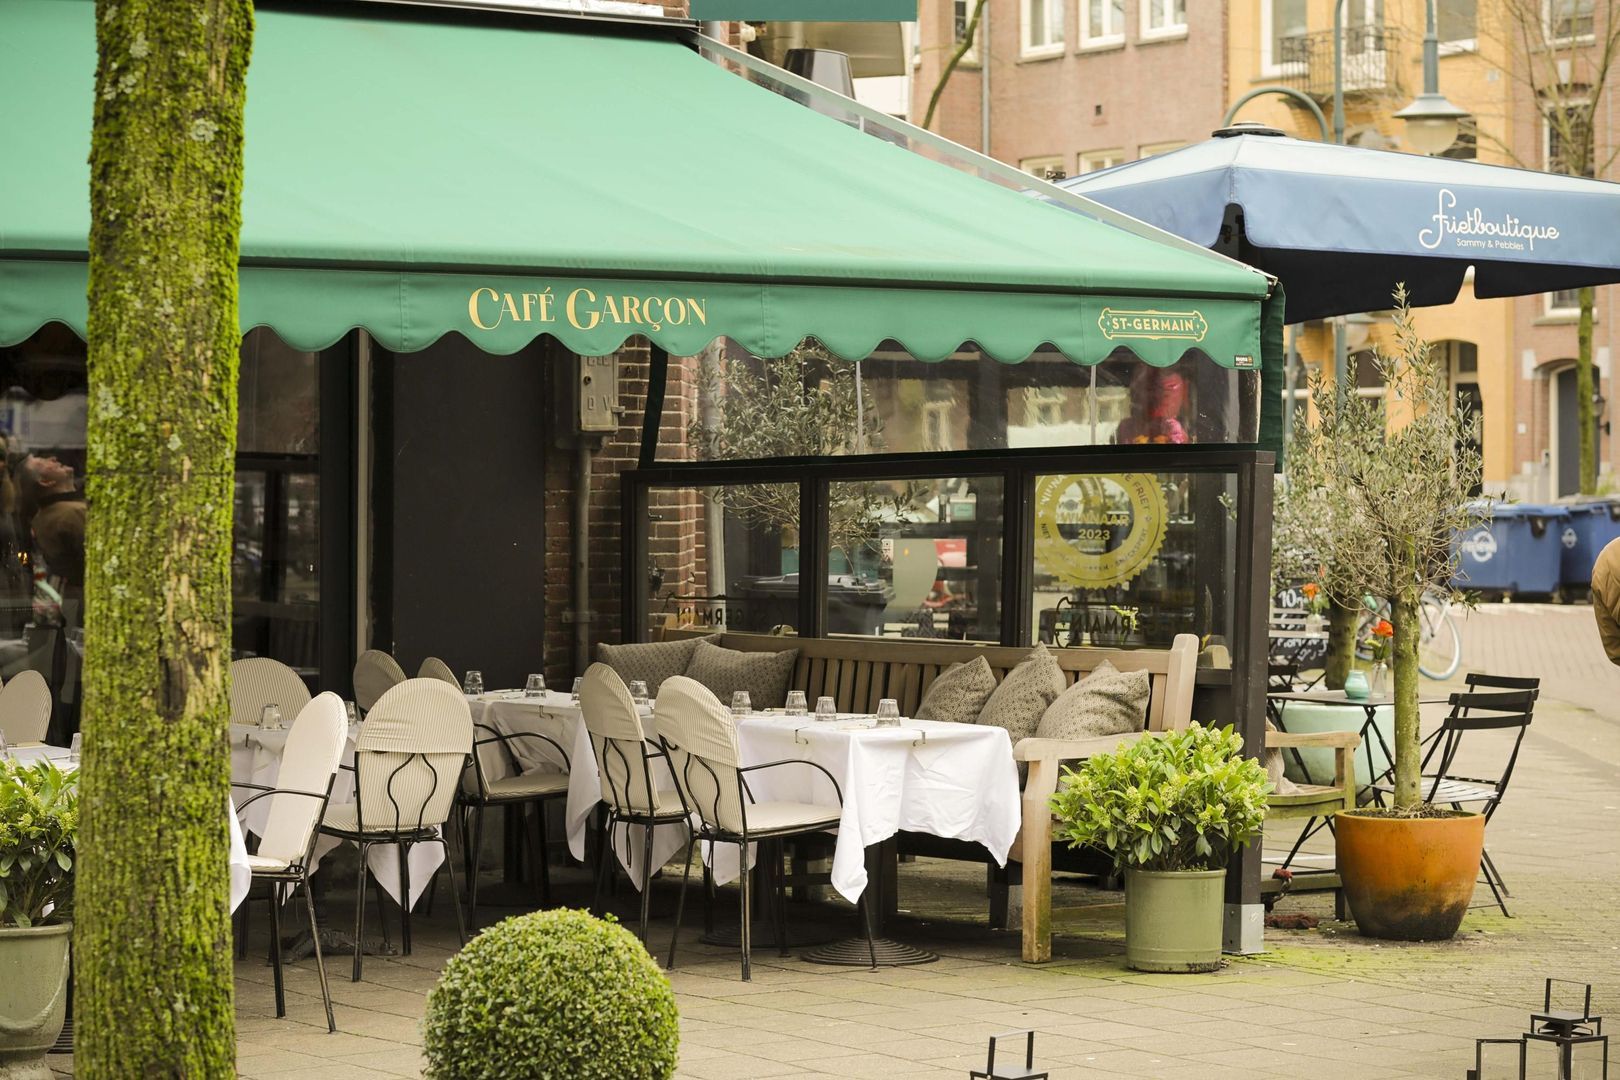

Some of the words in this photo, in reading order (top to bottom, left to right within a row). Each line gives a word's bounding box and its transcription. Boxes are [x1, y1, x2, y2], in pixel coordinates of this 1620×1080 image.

[1456, 237, 1486, 249] Sammy
[1488, 240, 1494, 248] &
[1495, 239, 1525, 251] Pebbles
[468, 287, 556, 330] CAFÉ
[566, 288, 707, 332] GARÇON
[1061, 511, 1130, 527] WINNAAR
[1078, 528, 1111, 541] 2023
